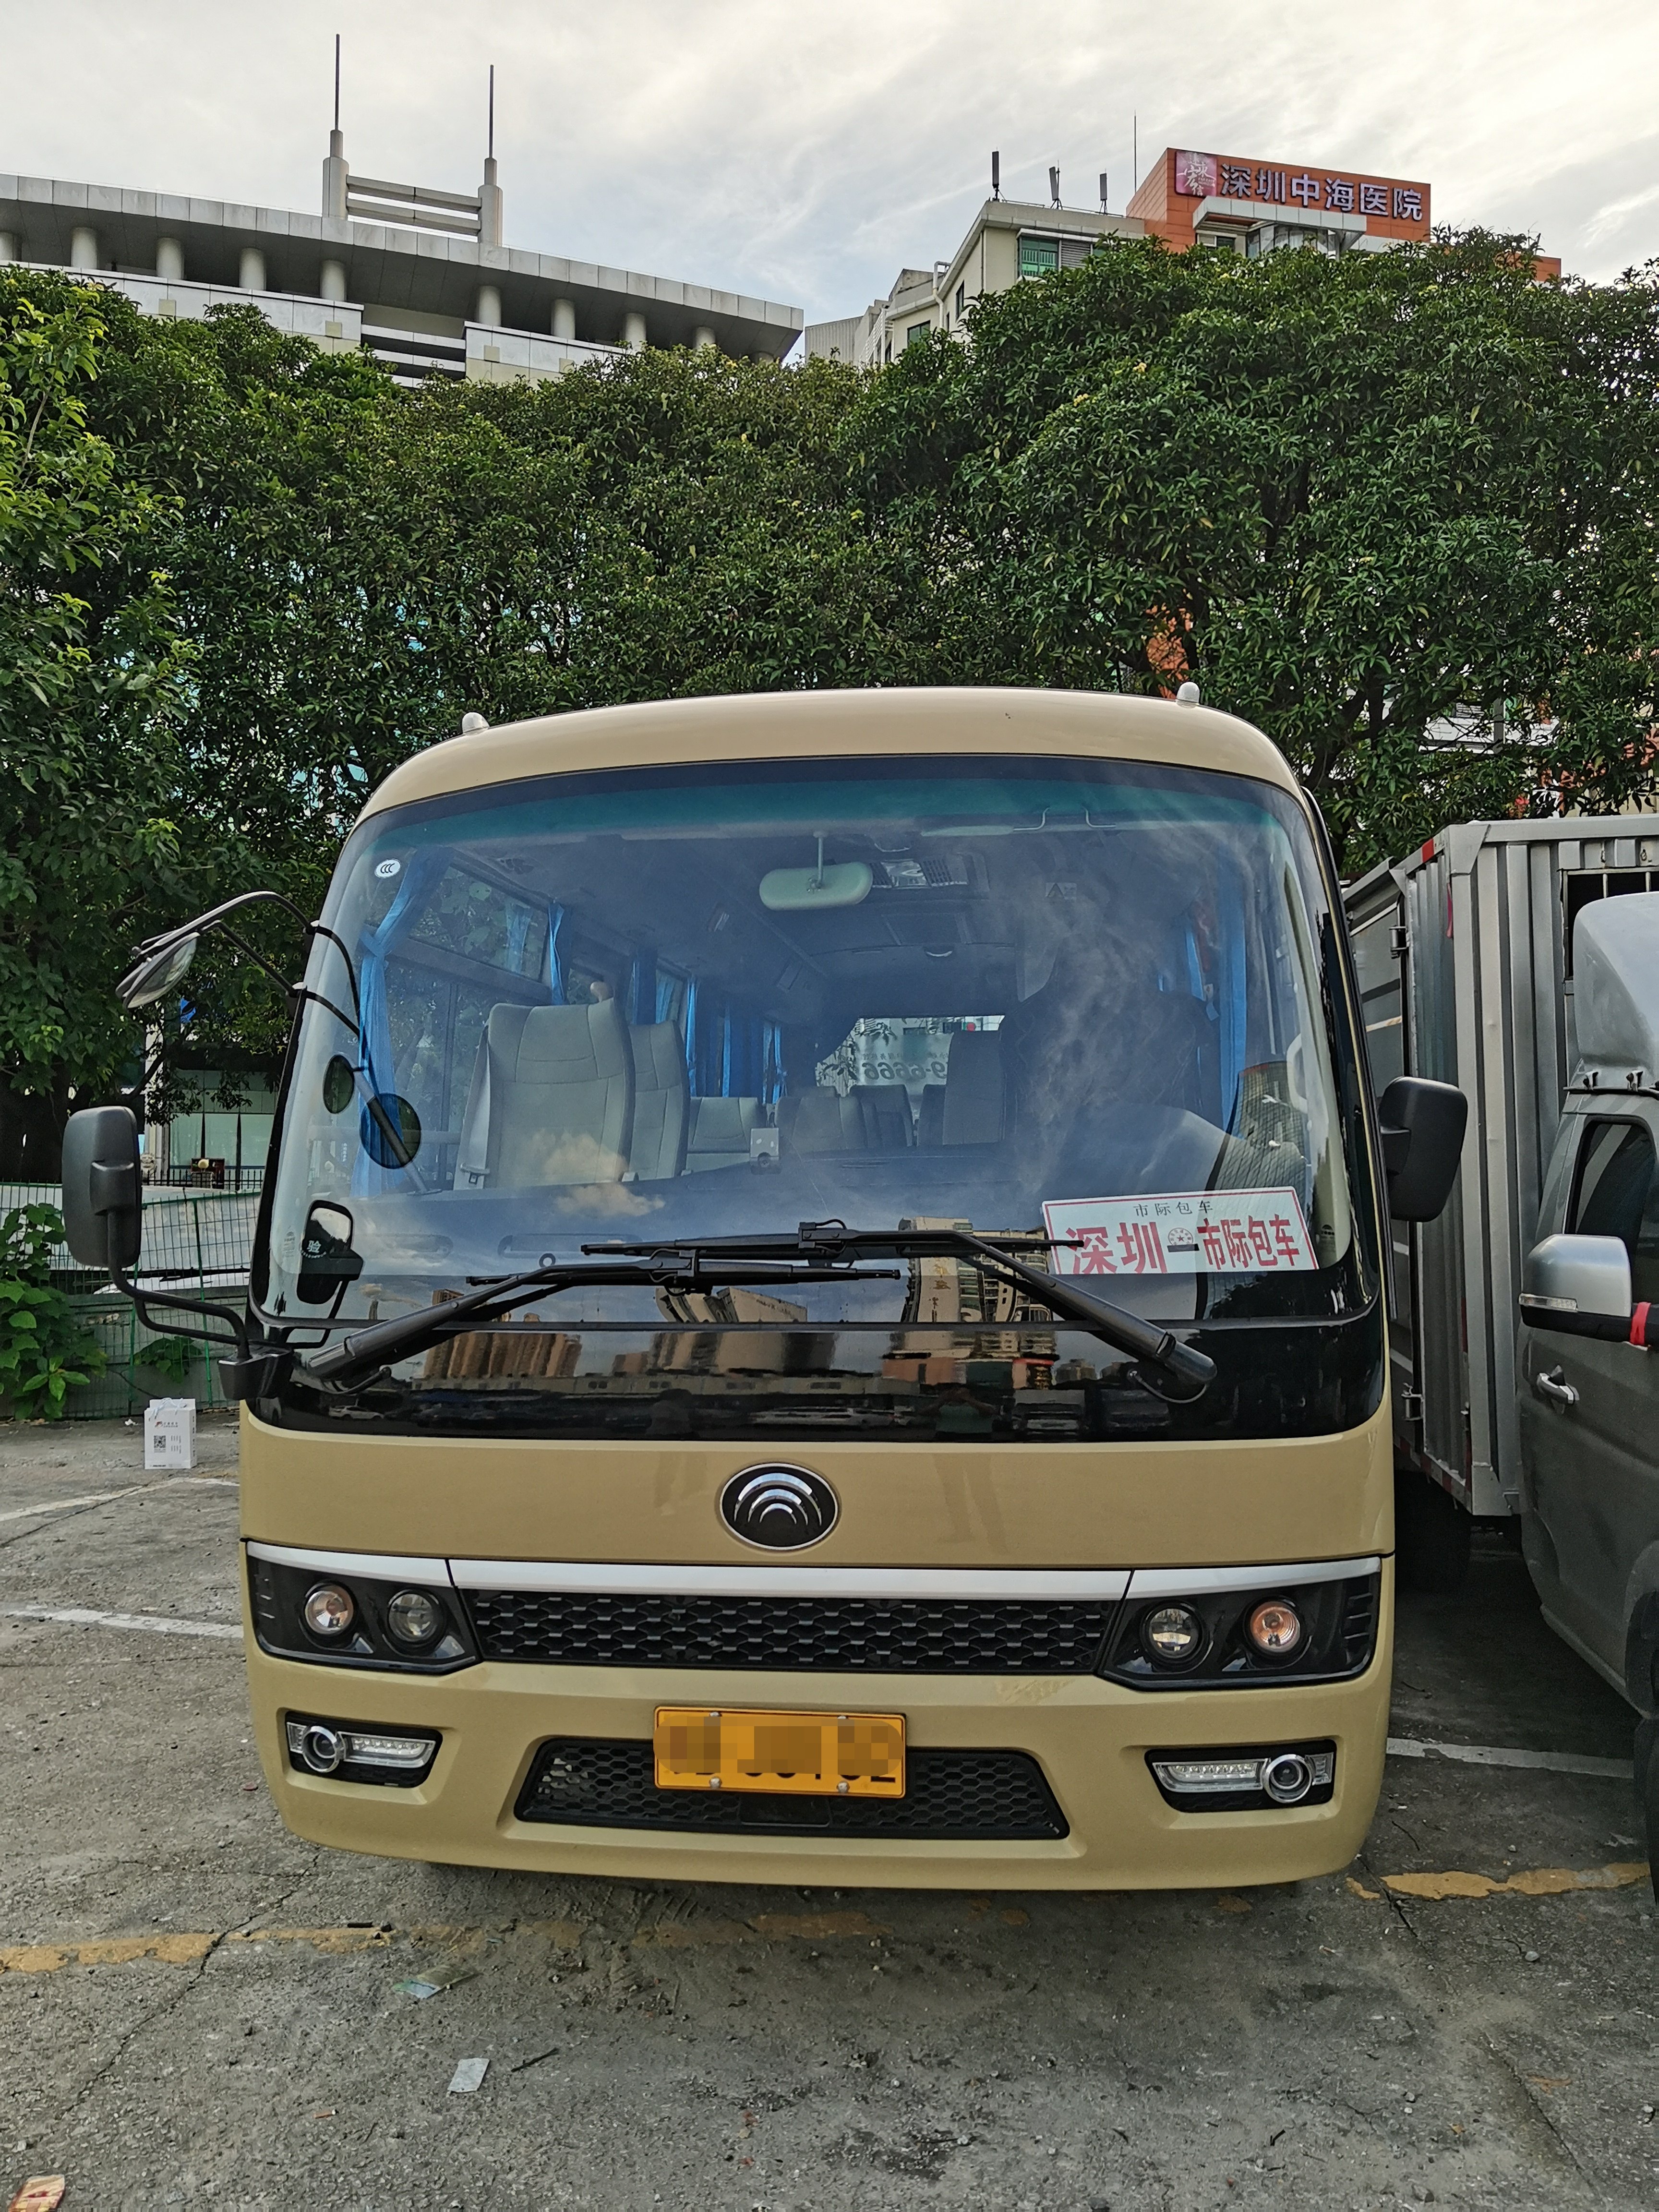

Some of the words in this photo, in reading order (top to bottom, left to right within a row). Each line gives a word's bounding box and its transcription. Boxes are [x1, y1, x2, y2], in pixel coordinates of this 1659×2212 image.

[1220, 163, 1423, 221] 深圳中海医院
[1133, 1200, 1214, 1217] 市际包车
